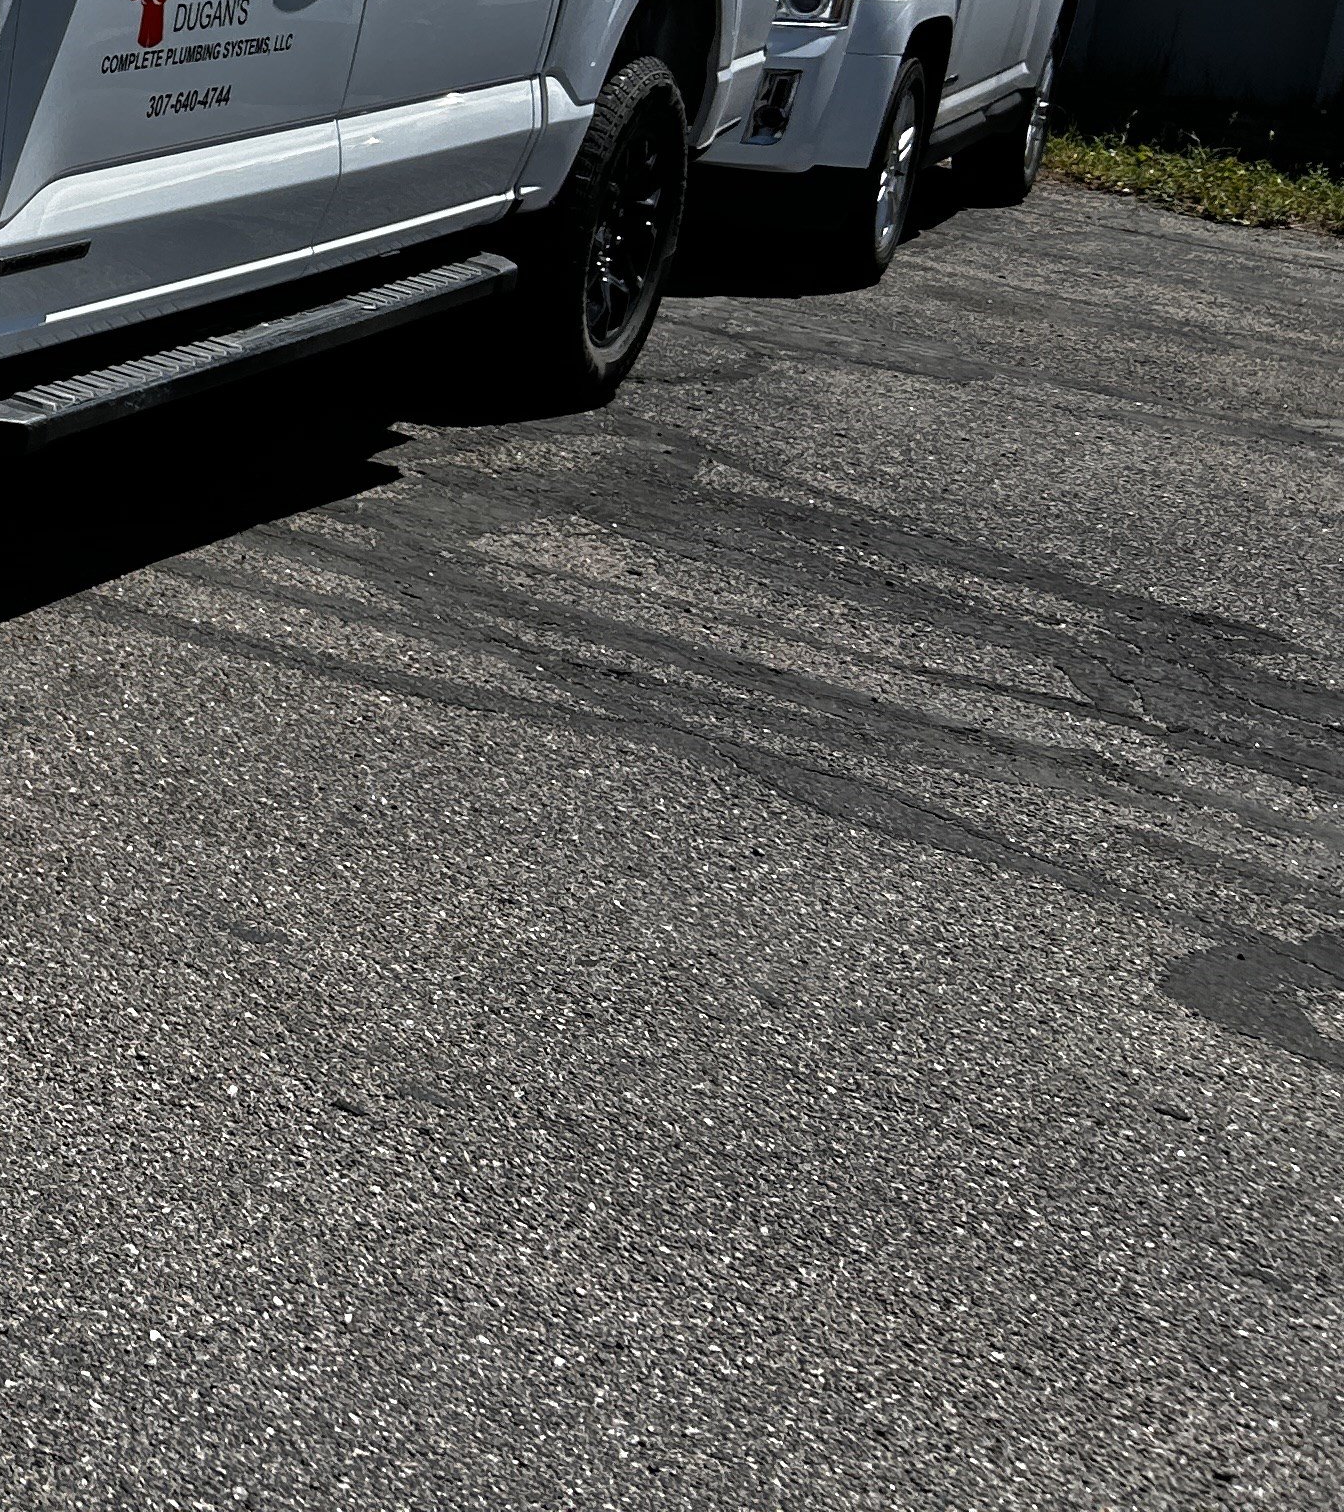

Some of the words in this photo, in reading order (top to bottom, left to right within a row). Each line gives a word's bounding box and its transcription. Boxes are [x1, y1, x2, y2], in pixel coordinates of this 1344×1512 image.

[101, 49, 164, 74] COMPLETE
[165, 42, 221, 66] PLUMBING
[222, 37, 271, 60] SYSTEMS,
[274, 33, 293, 52] LLC
[146, 85, 232, 118] 307-640-4744
